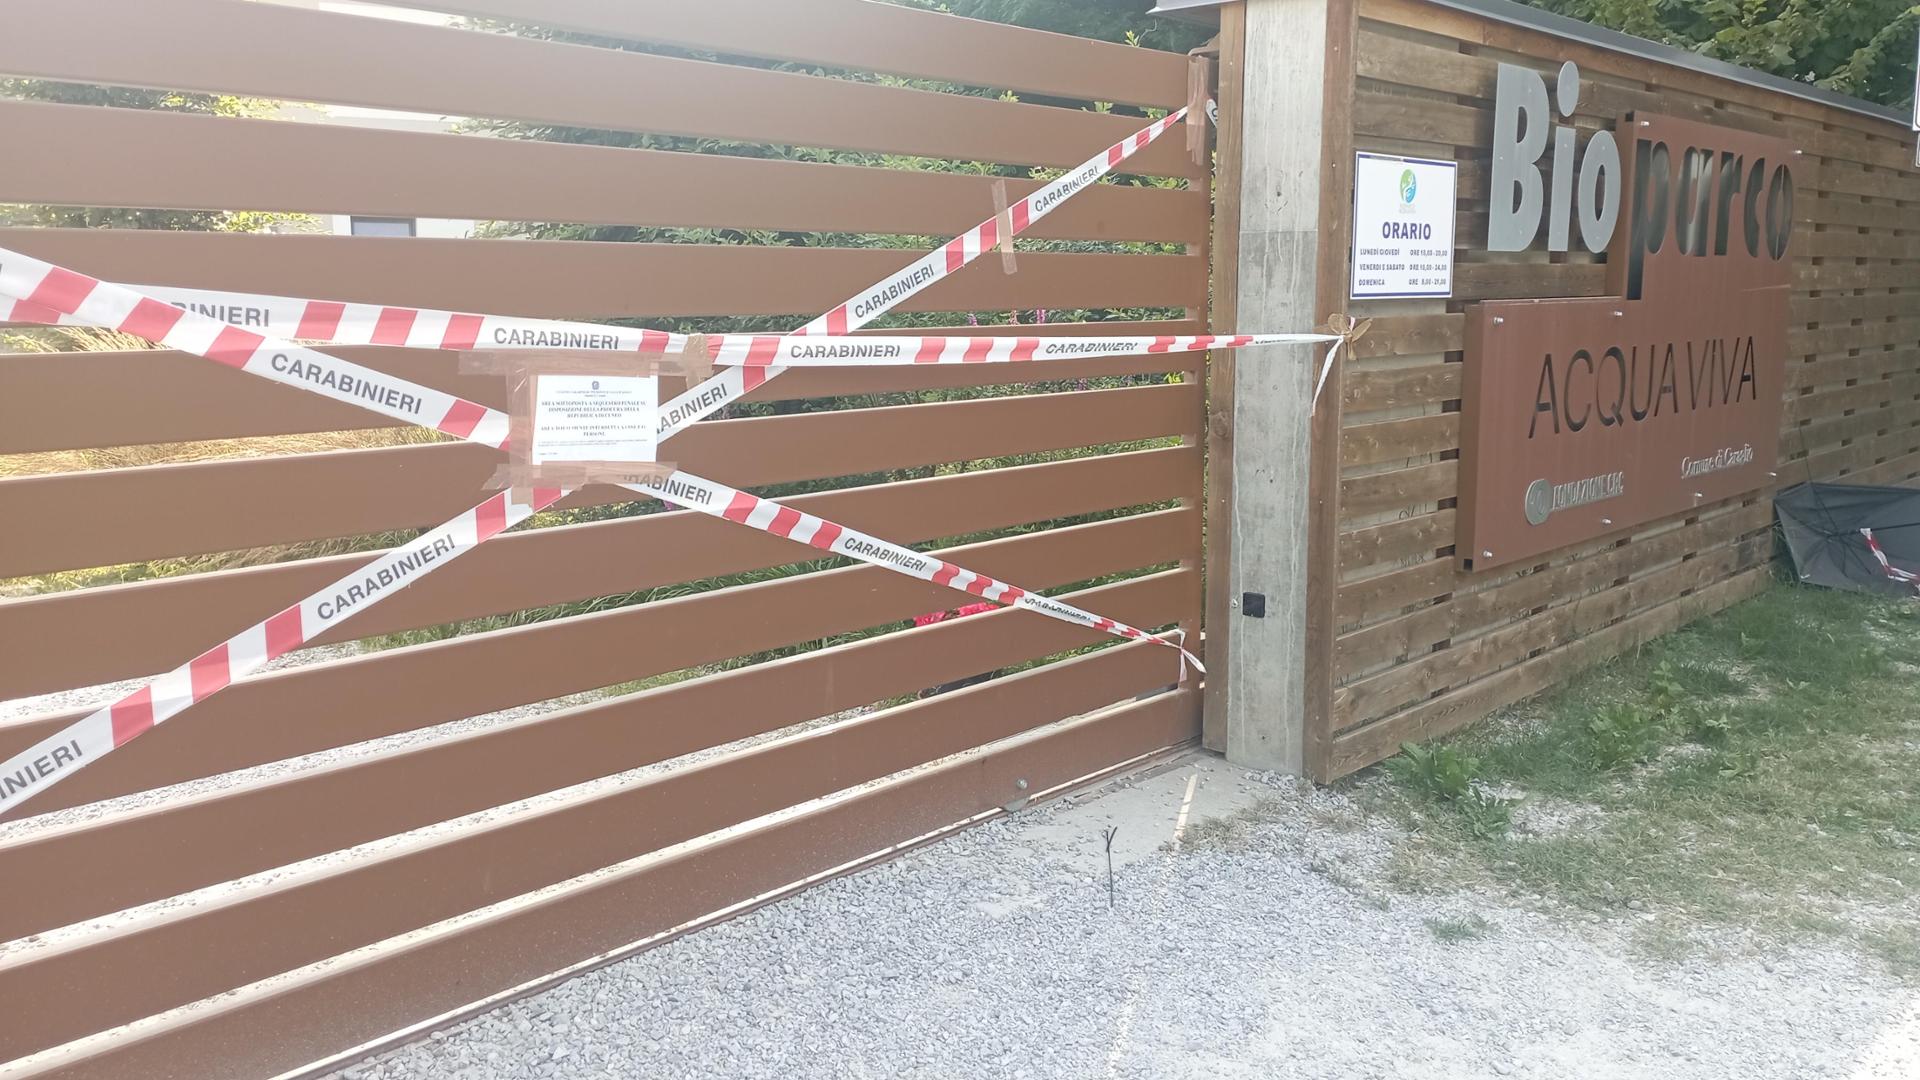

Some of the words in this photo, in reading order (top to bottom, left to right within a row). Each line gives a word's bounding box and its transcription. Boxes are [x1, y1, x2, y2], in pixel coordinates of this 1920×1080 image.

[1034, 165, 1100, 214] CARABINIERI
[1382, 221, 1432, 240] ORARIO
[1358, 278, 1385, 286] DOMENICA
[1387, 263, 1405, 271] SABATO
[854, 263, 935, 320] CARABINIERI
[494, 328, 619, 350] CARABINIERI
[790, 345, 900, 358] CARABINIERI
[1045, 342, 1138, 354] CARABINIERI
[270, 353, 422, 415] CARABINIERI
[1528, 343, 1679, 439] ACQUA
[1687, 336, 1757, 411] VIVA
[624, 473, 713, 505] ABINIERI
[844, 536, 927, 572] CARABINIERI
[317, 534, 456, 621] CARABINIERI
